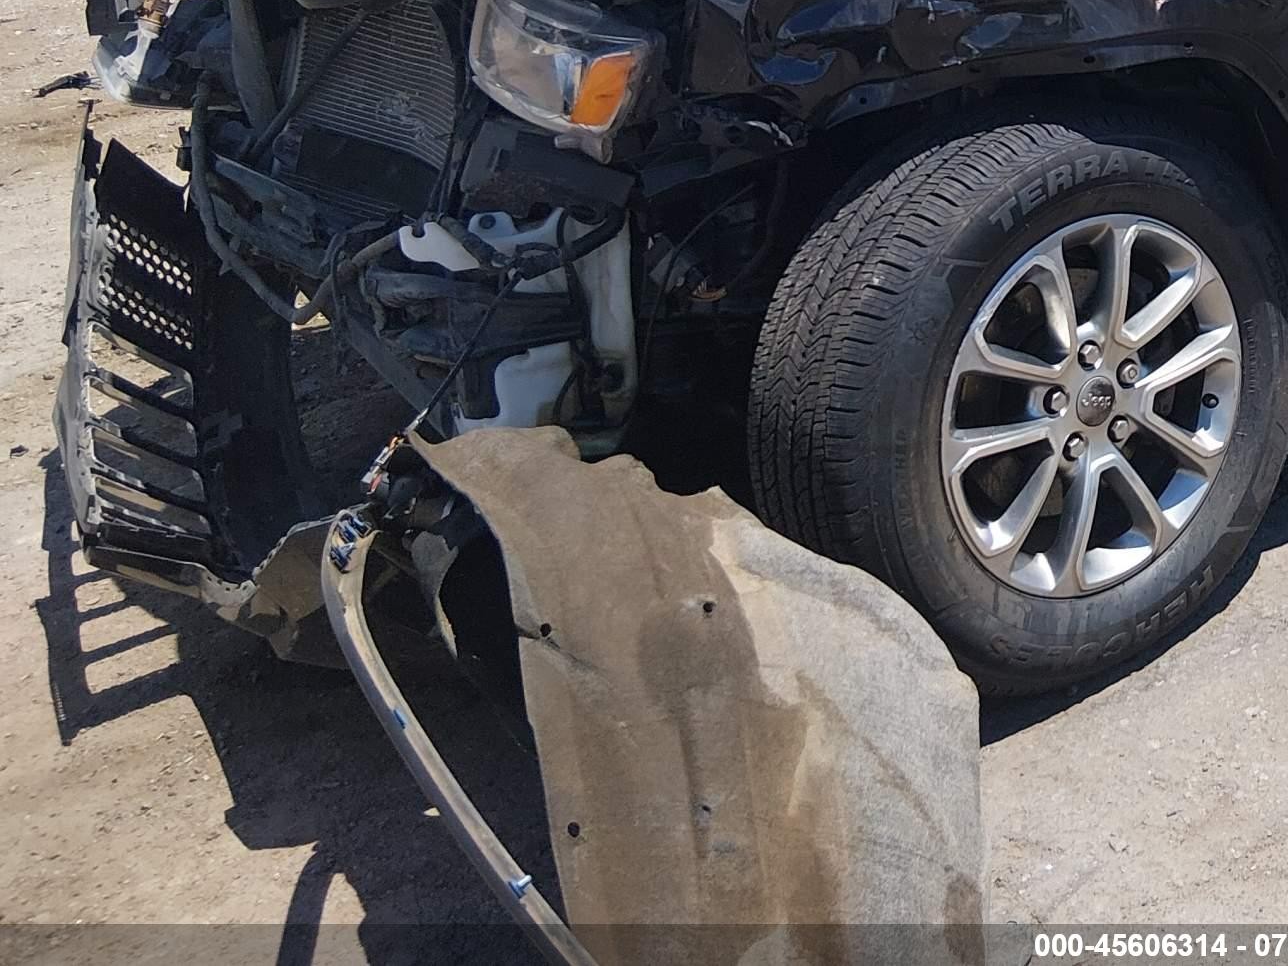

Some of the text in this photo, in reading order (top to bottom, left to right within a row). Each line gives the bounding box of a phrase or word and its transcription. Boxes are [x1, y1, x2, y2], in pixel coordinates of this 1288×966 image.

[988, 149, 1129, 235] TERRA
[1081, 392, 1111, 409] Jeep
[987, 564, 1215, 666] HERCULES
